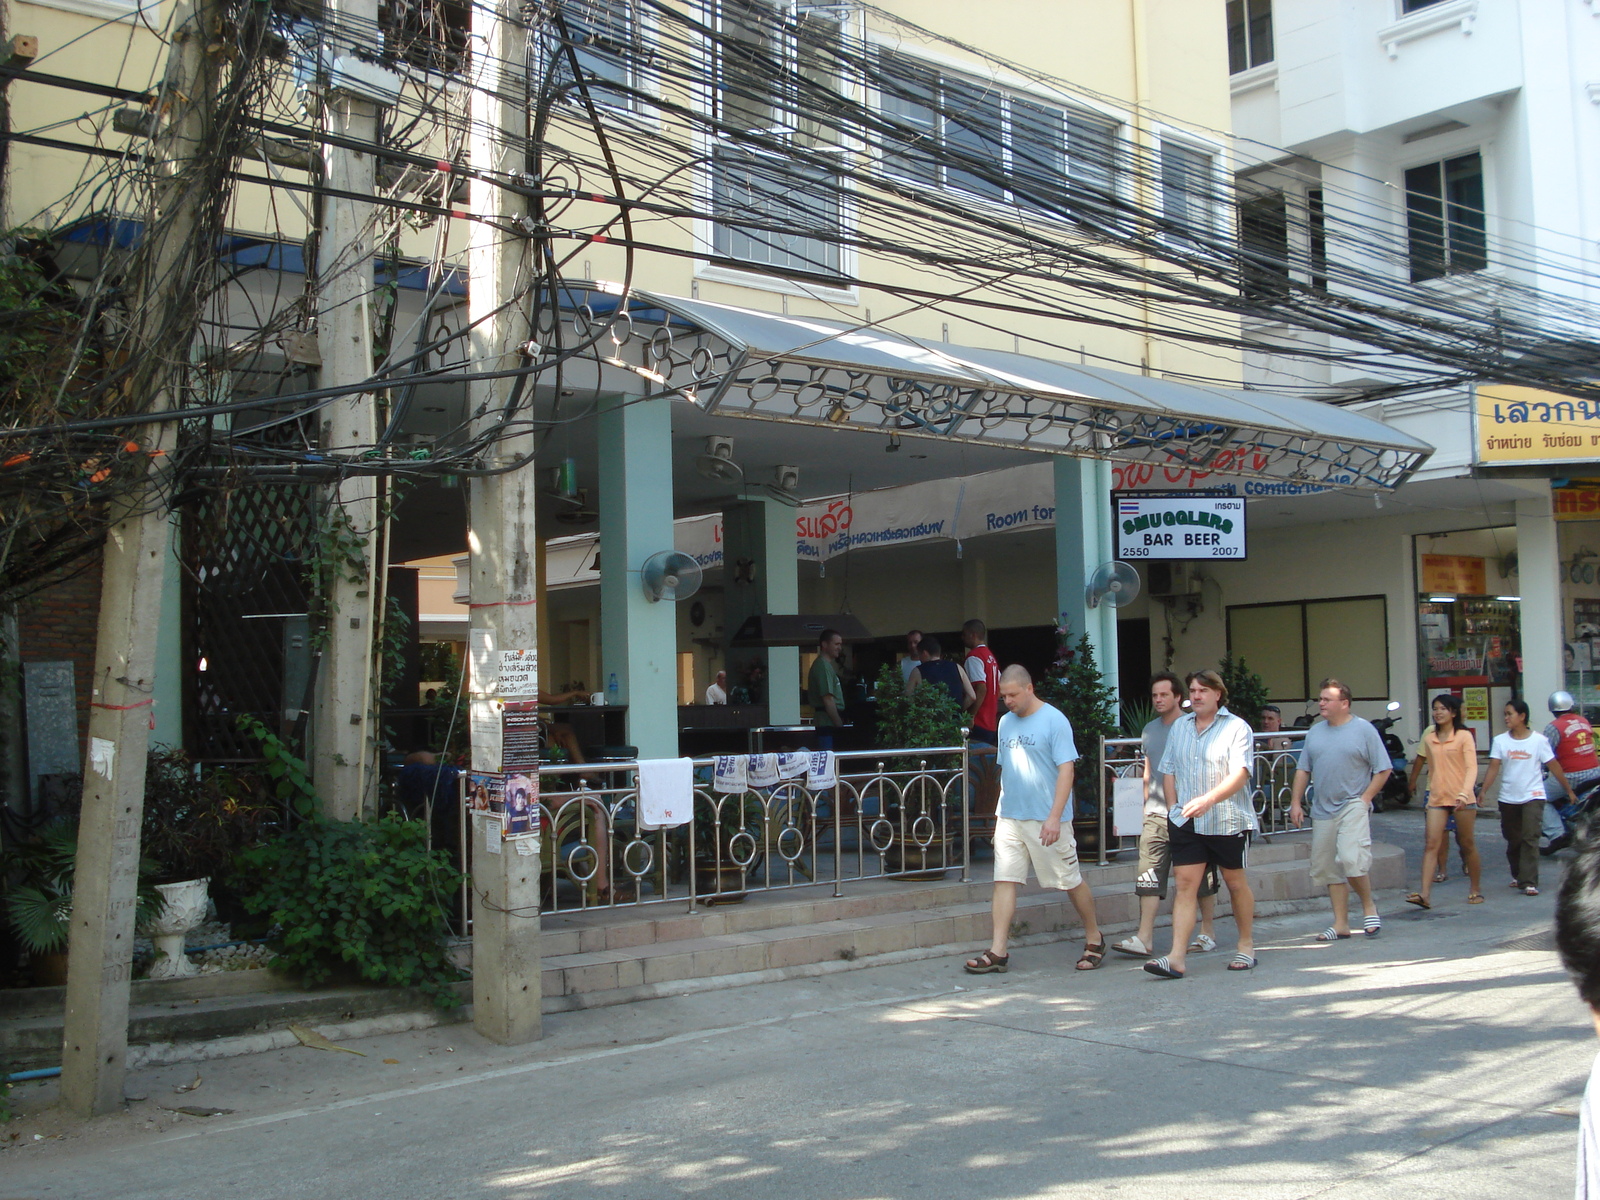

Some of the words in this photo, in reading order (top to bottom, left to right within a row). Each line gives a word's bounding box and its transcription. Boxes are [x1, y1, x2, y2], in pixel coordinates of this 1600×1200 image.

[1486, 434, 1532, 450] จำหน่าย
[1542, 432, 1582, 448] รับซ่อม
[986, 509, 1028, 532] Room
[1031, 504, 1056, 523] for
[1122, 510, 1234, 536] SMUGGLERS
[1143, 533, 1174, 546] BAR
[1184, 532, 1221, 546] BEER
[1122, 547, 1150, 557] 2550
[1212, 547, 1239, 556] 2007
